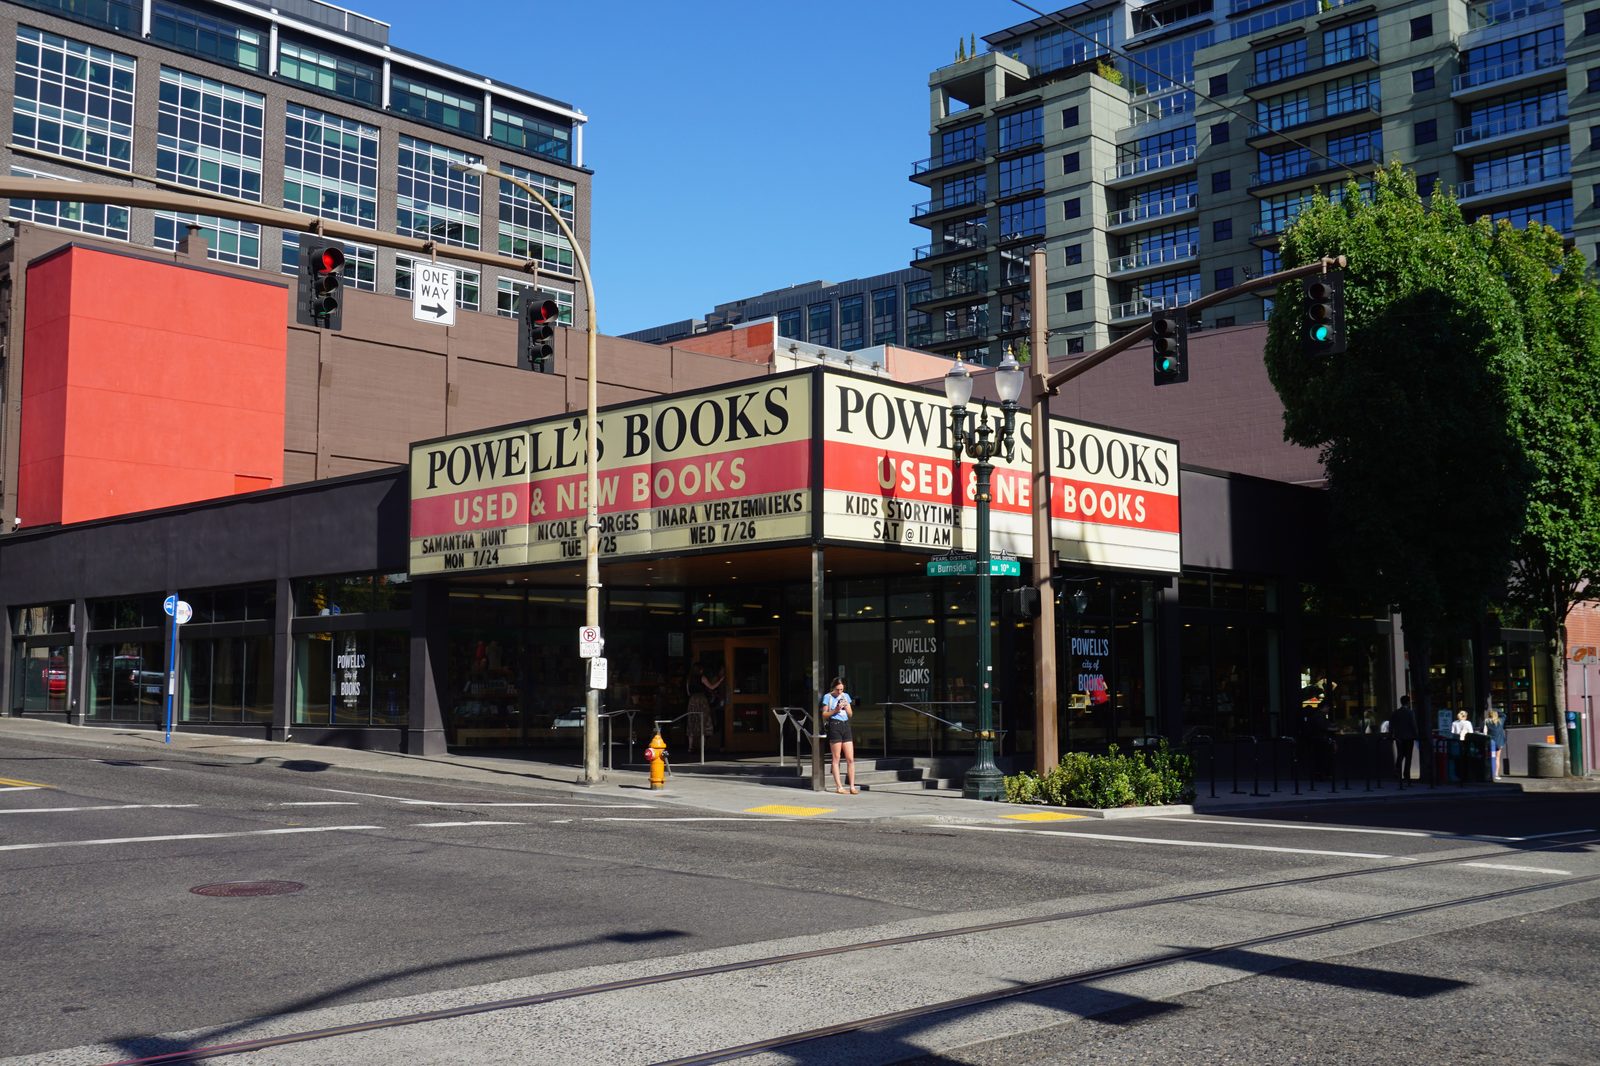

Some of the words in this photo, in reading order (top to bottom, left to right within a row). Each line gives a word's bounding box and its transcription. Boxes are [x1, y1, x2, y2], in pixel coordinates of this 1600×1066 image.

[422, 269, 449, 286] ONE
[421, 284, 450, 300] WAY
[426, 418, 605, 490] POWELL'S
[623, 385, 790, 459] BOOKS
[1054, 428, 1169, 486] BOOKS
[453, 492, 518, 525] USED
[530, 488, 546, 516] &
[556, 475, 620, 512] NEW
[632, 457, 746, 502] BOOKS
[877, 456, 953, 496] USED
[1063, 484, 1146, 523] BOOKS
[657, 506, 698, 527] INARA
[704, 493, 803, 521] VERZEMNIEKS
[846, 494, 878, 517] KIDS
[887, 500, 960, 526] STORYTIME
[537, 520, 577, 540] NICOLE
[583, 513, 639, 534] ORGES
[690, 525, 716, 545] WED
[722, 520, 757, 541] 7/26
[873, 520, 899, 541] SAT
[905, 528, 914, 542] @
[422, 534, 475, 554] SAMANTHA
[481, 529, 508, 547] HUNT
[561, 539, 582, 557] TUE
[444, 553, 465, 569] MON
[473, 549, 499, 567] 7/24
[937, 563, 967, 573] Burnside
[892, 636, 937, 654] POWELL'S
[1071, 637, 1109, 656] POWELL'S
[337, 654, 366, 669] POWELL'S
[904, 656, 916, 667] city
[917, 655, 926, 667] of
[1081, 659, 1092, 671] city
[1093, 659, 1101, 671] of
[899, 668, 930, 685] BOOKS
[1078, 673, 1104, 691] BOOKS
[340, 681, 361, 696] BOOKS
